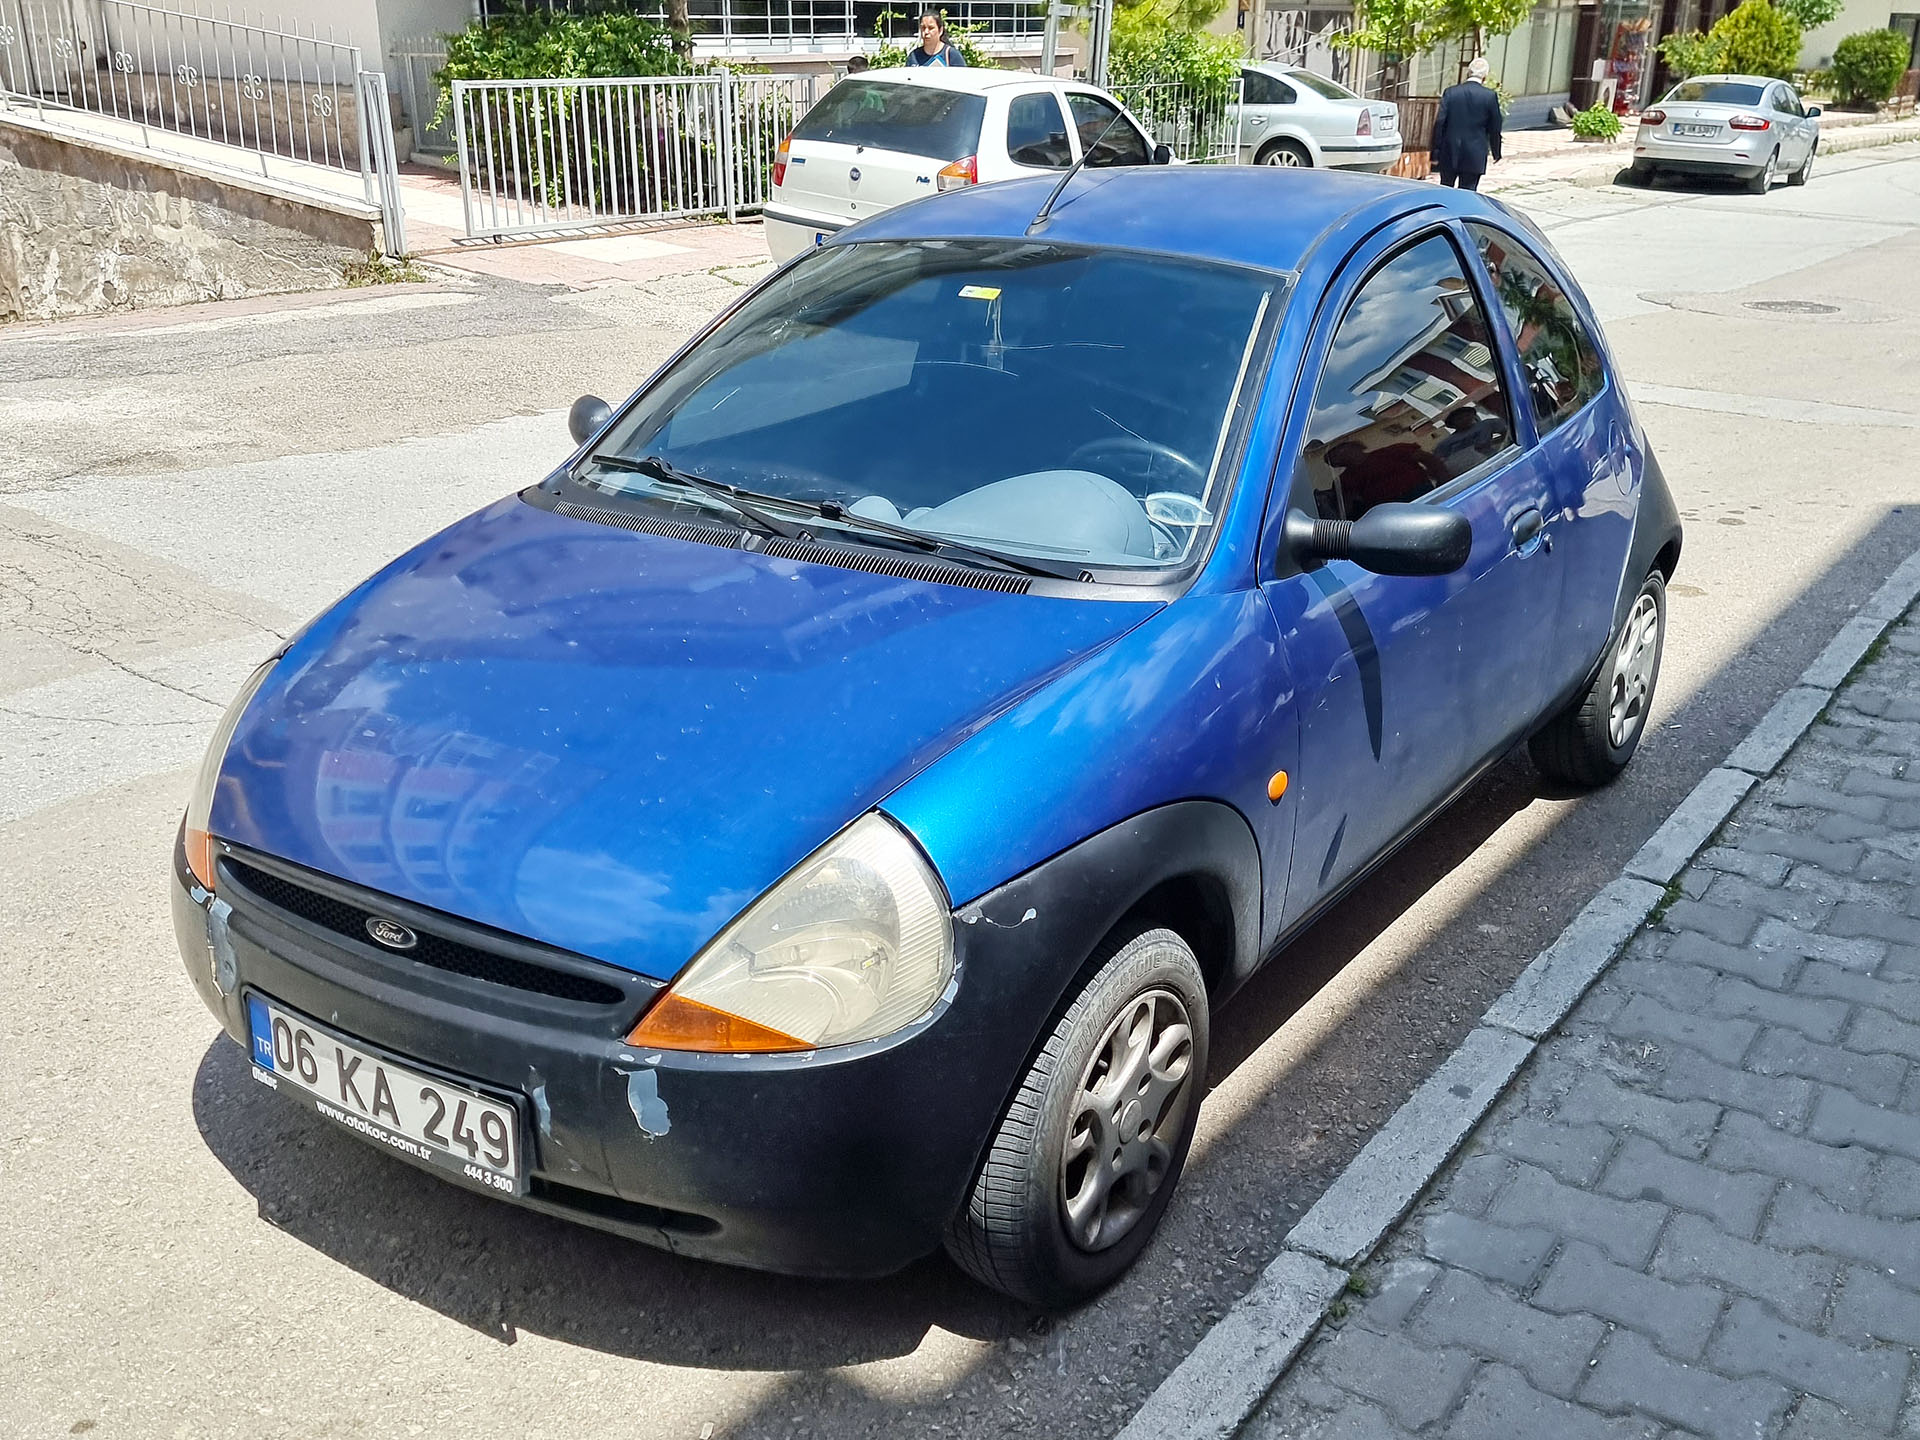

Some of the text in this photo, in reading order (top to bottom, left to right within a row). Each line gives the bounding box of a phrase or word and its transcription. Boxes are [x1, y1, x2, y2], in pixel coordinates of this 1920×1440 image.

[375, 922, 404, 943] Ford
[256, 1036, 272, 1057] TR
[272, 1016, 510, 1168] 06 KA 249
[463, 1164, 513, 1193] 444 3 300
